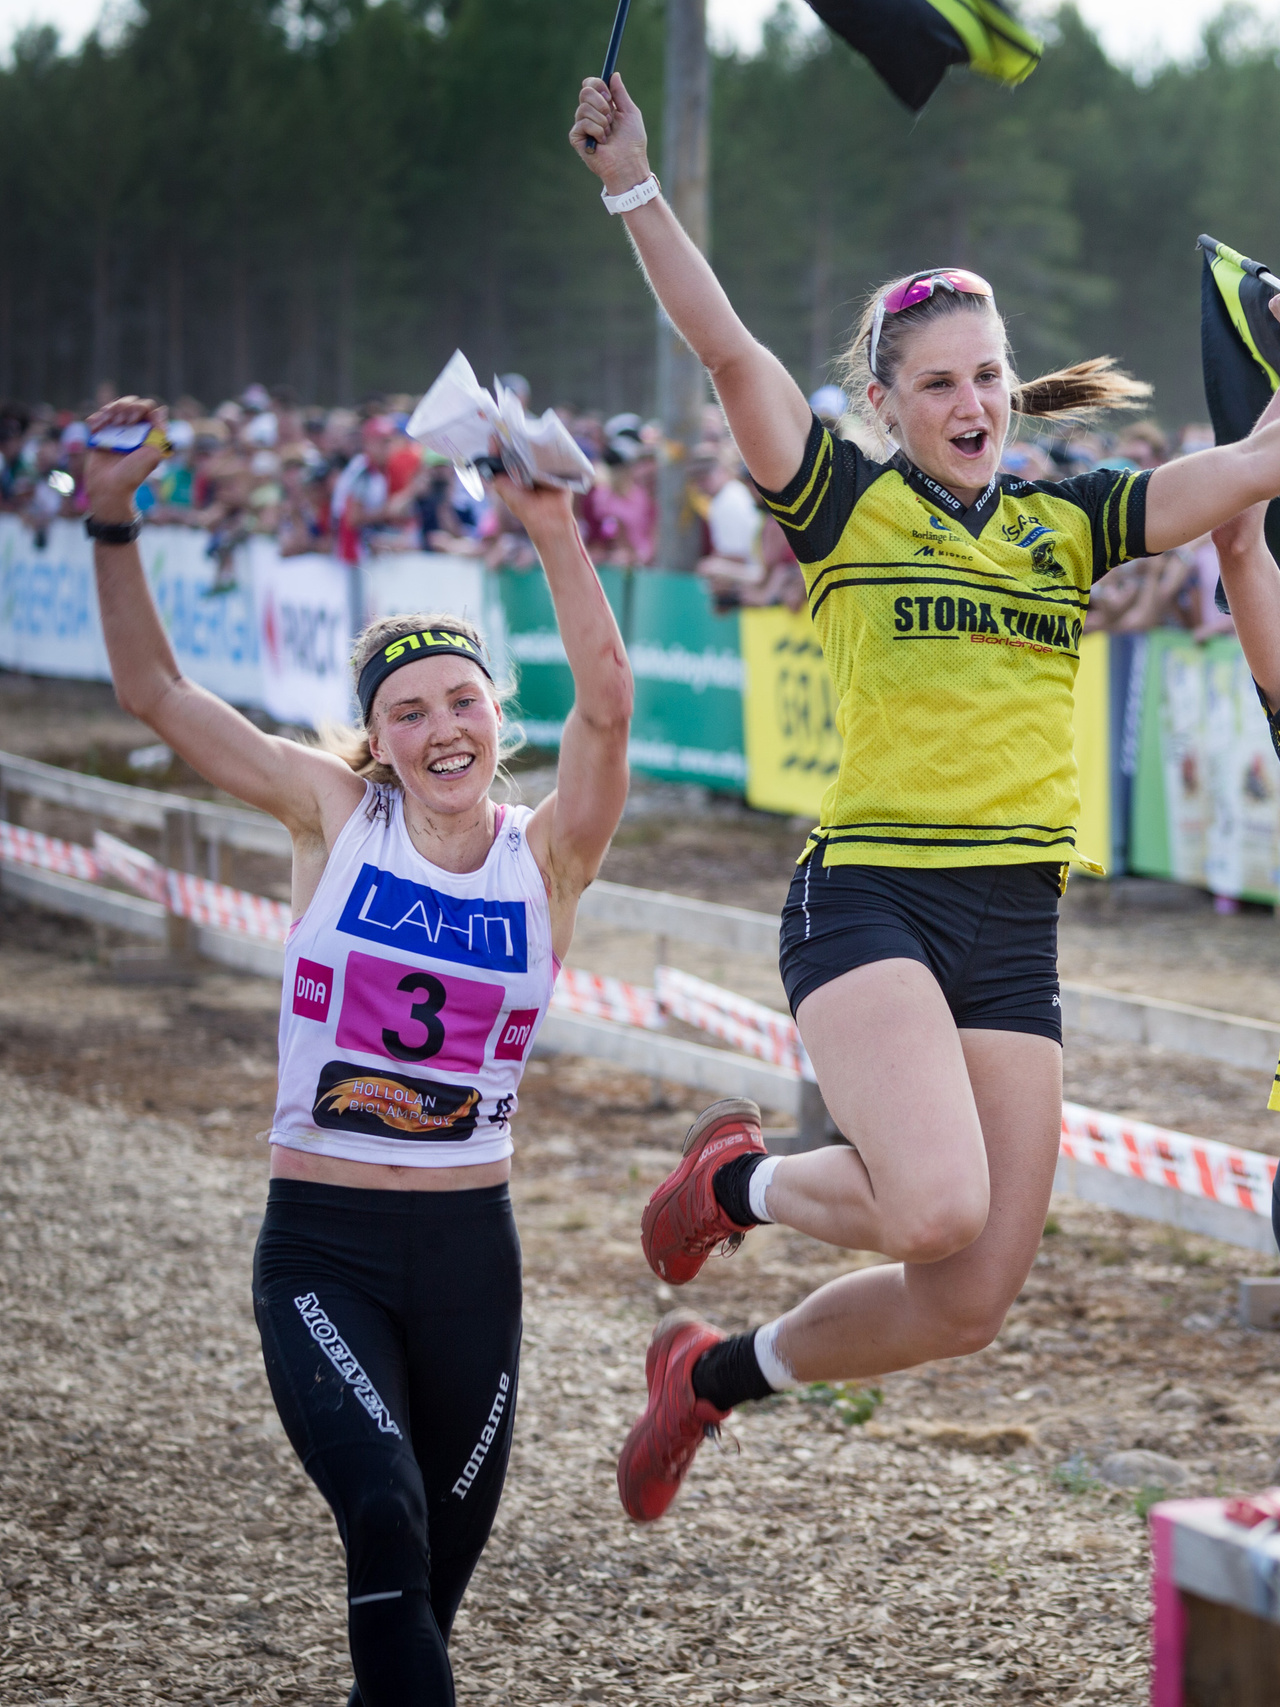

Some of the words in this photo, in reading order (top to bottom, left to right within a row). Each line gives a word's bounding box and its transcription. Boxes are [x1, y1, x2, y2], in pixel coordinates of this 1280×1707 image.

[923, 477, 962, 510] ICEBUG
[893, 596, 999, 635] STORA
[1000, 606, 1069, 648] TUNA
[970, 634, 1054, 655] Borlänge
[381, 971, 447, 1063] 3
[349, 1100, 429, 1125] BIOLÄMPÖ
[433, 1115, 451, 1126] OY
[352, 1080, 437, 1109] HOLLOLAN
[293, 1292, 404, 1441] MOELVEN
[451, 1371, 511, 1500] noname
